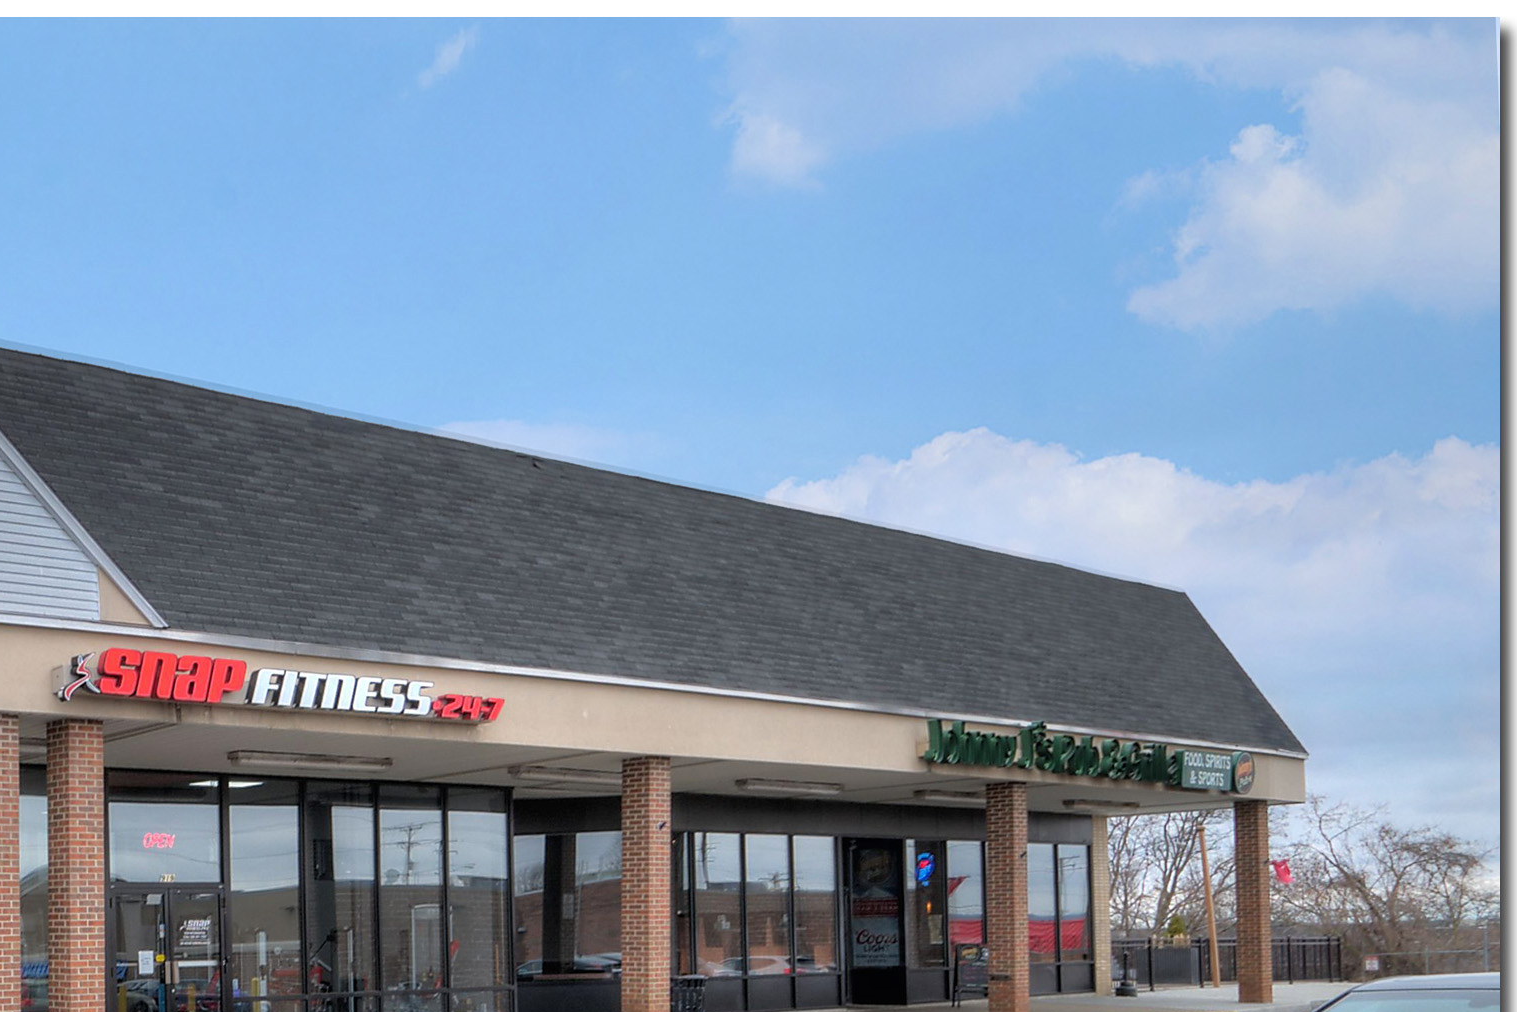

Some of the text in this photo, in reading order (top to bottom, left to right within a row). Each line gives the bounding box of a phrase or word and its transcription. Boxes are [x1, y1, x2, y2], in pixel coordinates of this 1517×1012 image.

[1205, 753, 1231, 770] SPIRITS
[1189, 770, 1197, 784] &
[1197, 770, 1225, 787] SPORTS
[142, 832, 176, 849] OPEN
[856, 928, 899, 945] Coors
